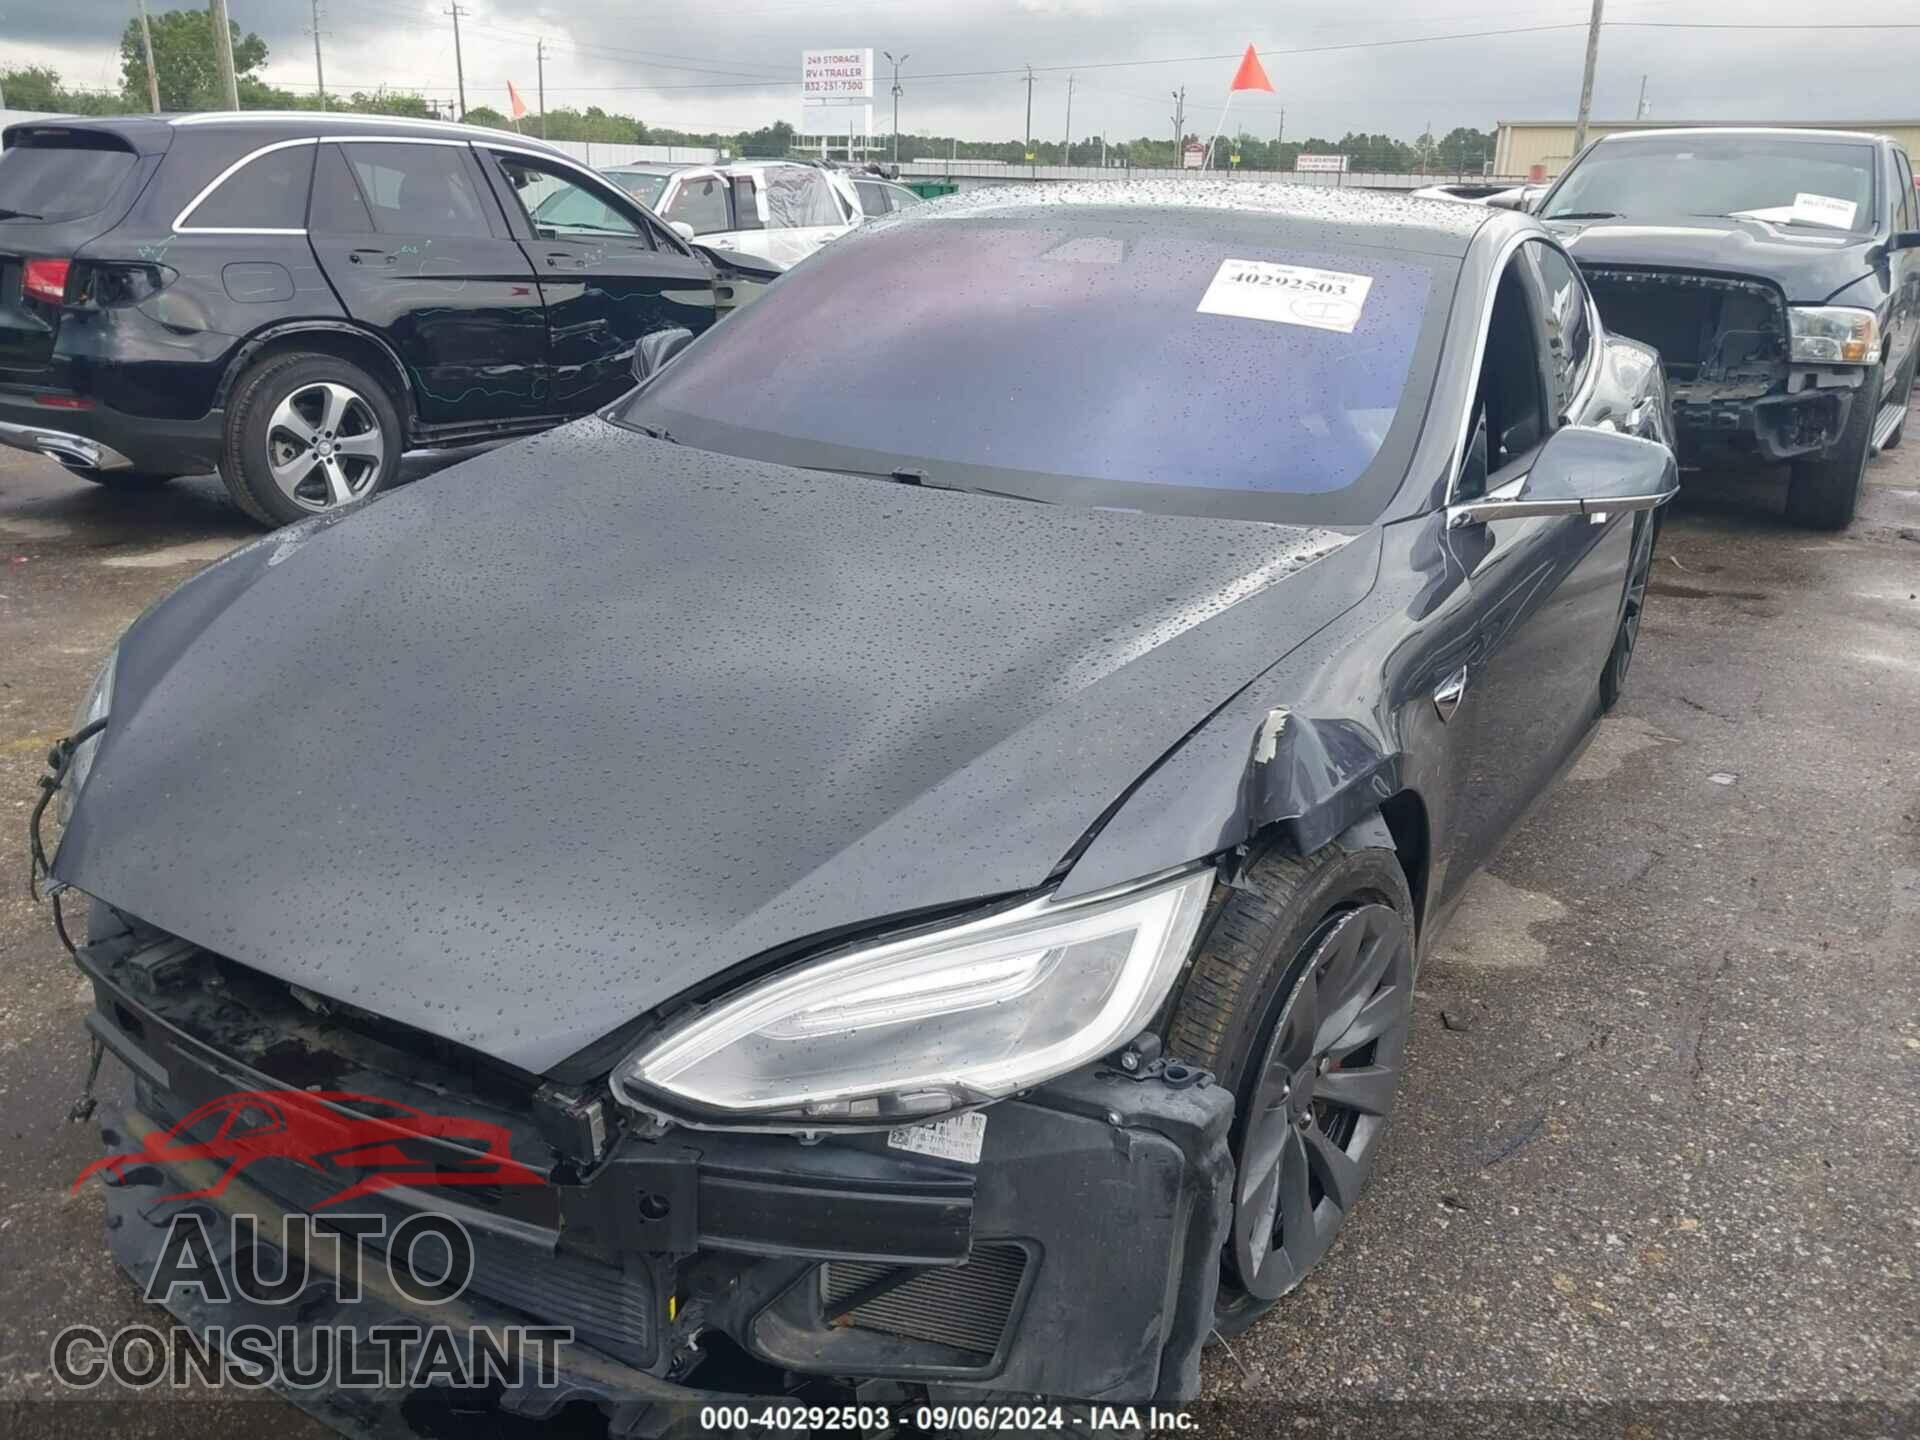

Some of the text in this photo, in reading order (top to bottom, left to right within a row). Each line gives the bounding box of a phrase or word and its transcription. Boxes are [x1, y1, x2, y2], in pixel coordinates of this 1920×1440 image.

[823, 54, 860, 64] STORAGE
[806, 69, 818, 78] RV
[824, 67, 862, 78] TRAILER
[1230, 272, 1348, 295] 40292503
